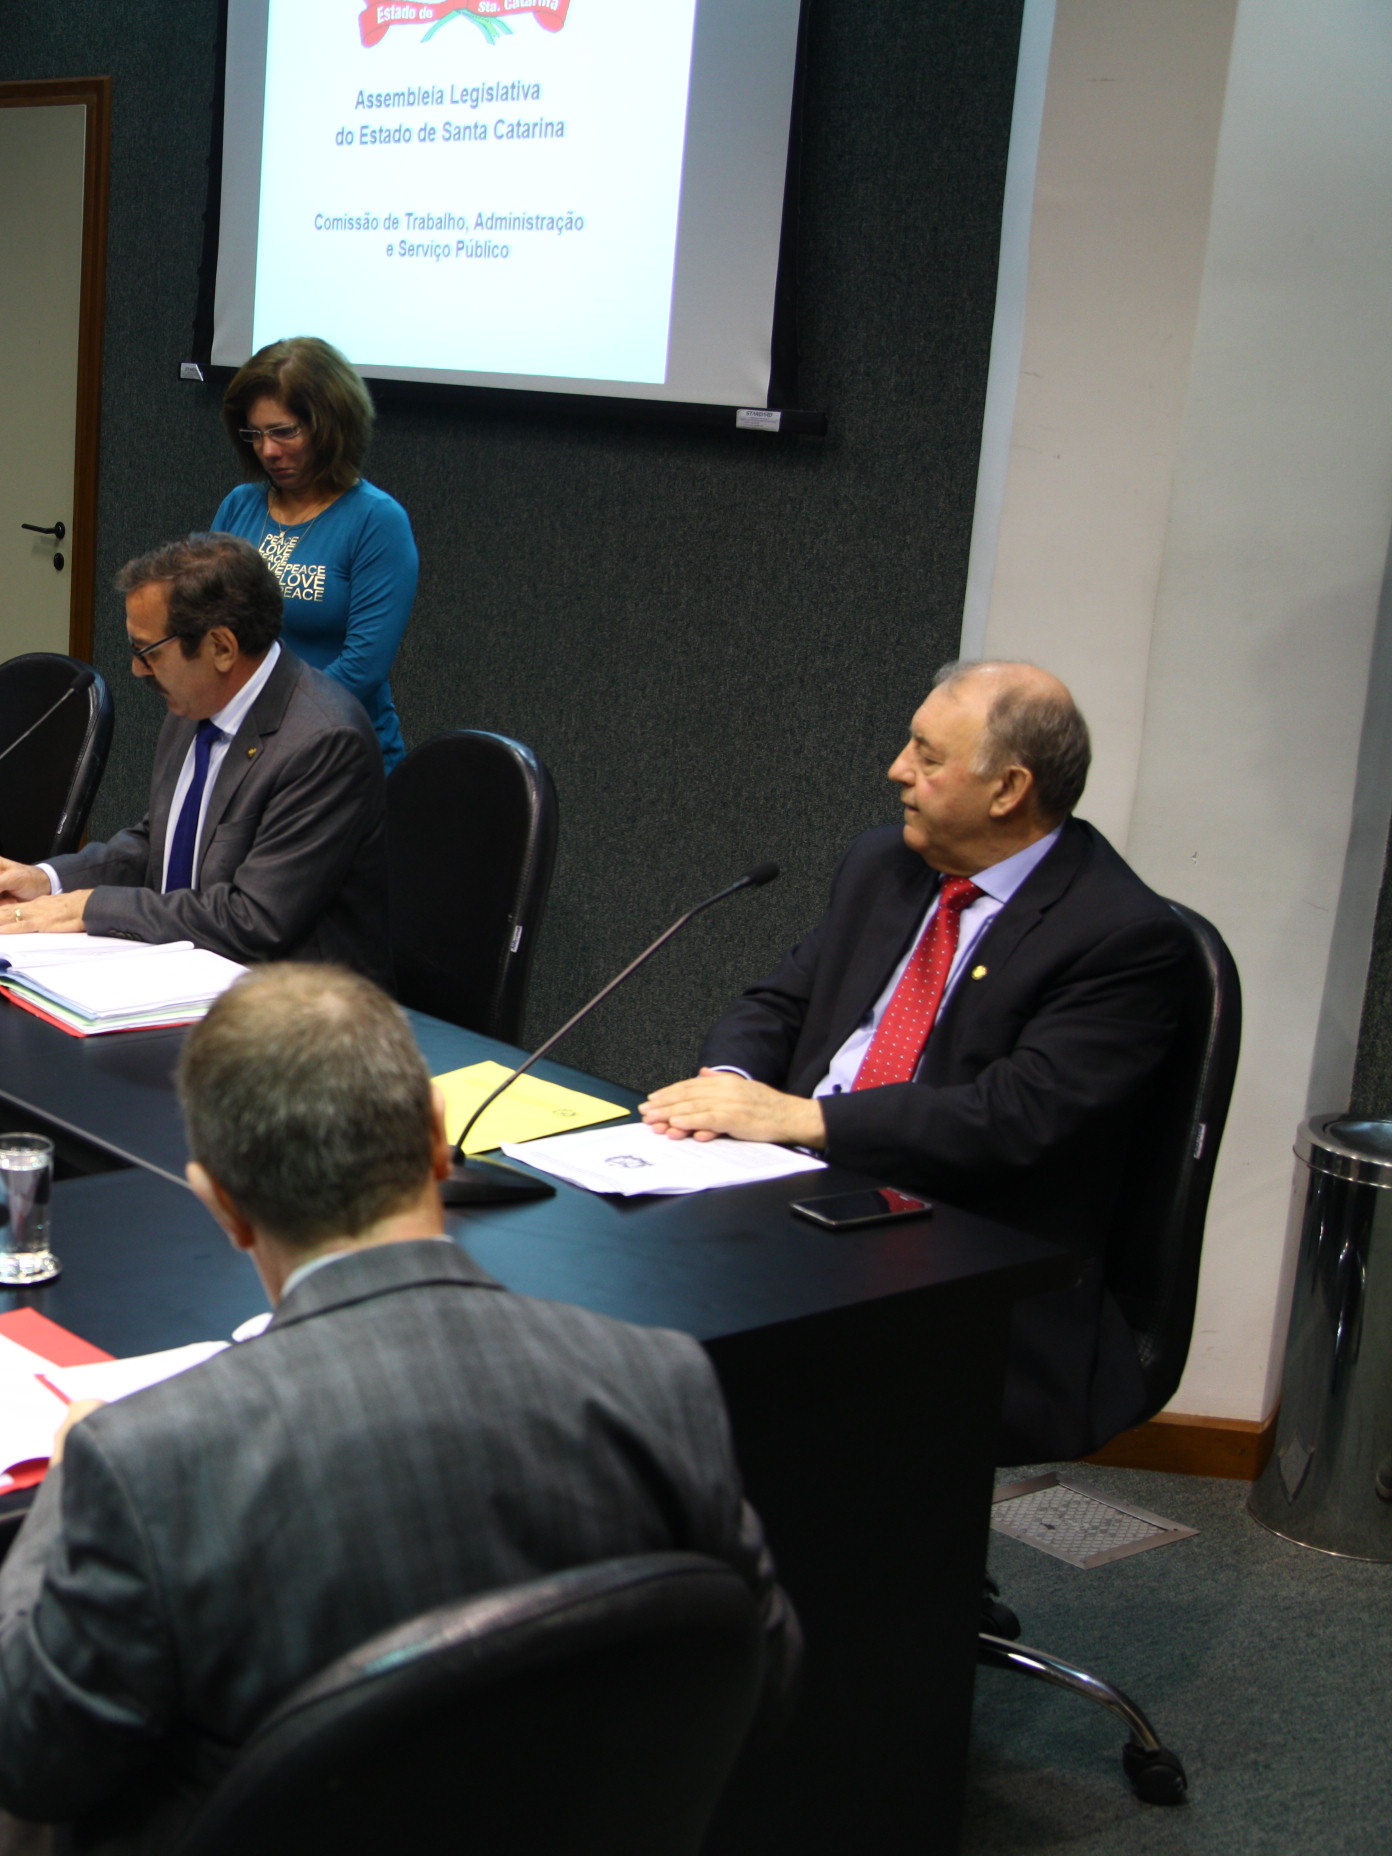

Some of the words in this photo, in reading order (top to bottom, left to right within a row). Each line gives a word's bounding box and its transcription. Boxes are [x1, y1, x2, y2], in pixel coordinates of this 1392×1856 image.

[376, 5, 416, 24] Estado
[419, 7, 433, 19] de
[477, 0, 501, 13] Sta.
[355, 85, 444, 110] Assembleia
[449, 80, 541, 109] Legislativa
[335, 126, 354, 146] do
[359, 123, 412, 146] Estado
[418, 122, 436, 143] de
[442, 120, 488, 142] Santa
[493, 117, 565, 140] Catarina
[314, 212, 379, 231] Comissão
[383, 213, 399, 231] de
[405, 212, 469, 233] Trabalho,
[473, 211, 584, 235] Administração
[386, 243, 394, 258] e
[398, 239, 451, 262] Serviço
[456, 239, 509, 259] Público
[259, 542, 295, 556] LOVE
[265, 534, 299, 546] PEACE
[284, 564, 326, 577] PEACE
[279, 573, 326, 590] LOVE
